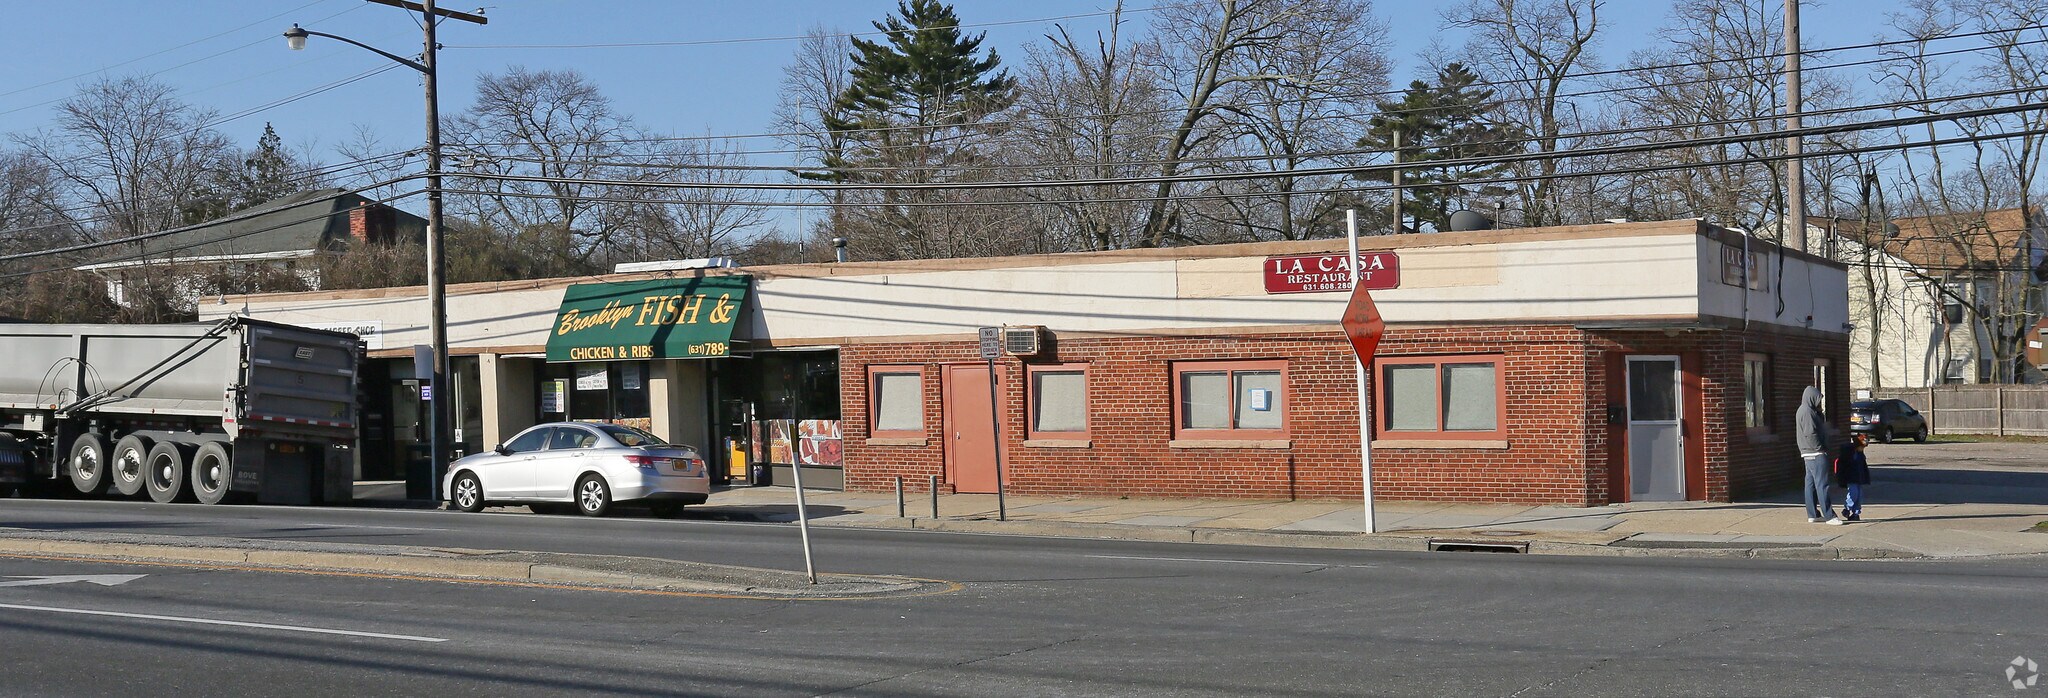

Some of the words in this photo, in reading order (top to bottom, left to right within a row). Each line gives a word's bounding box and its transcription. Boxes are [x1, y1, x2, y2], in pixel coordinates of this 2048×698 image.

[1275, 259, 1305, 275] LA
[1318, 255, 1385, 272] CASA
[1726, 248, 1735, 265] LA
[1738, 251, 1755, 269] CSA
[1303, 282, 1352, 291] 631.608.280
[557, 299, 635, 336] Brooklyn
[635, 294, 707, 326] FISH
[709, 293, 735, 324] &
[570, 346, 615, 360] CHICKEN
[619, 346, 627, 358] &
[632, 345, 655, 358] RIBS
